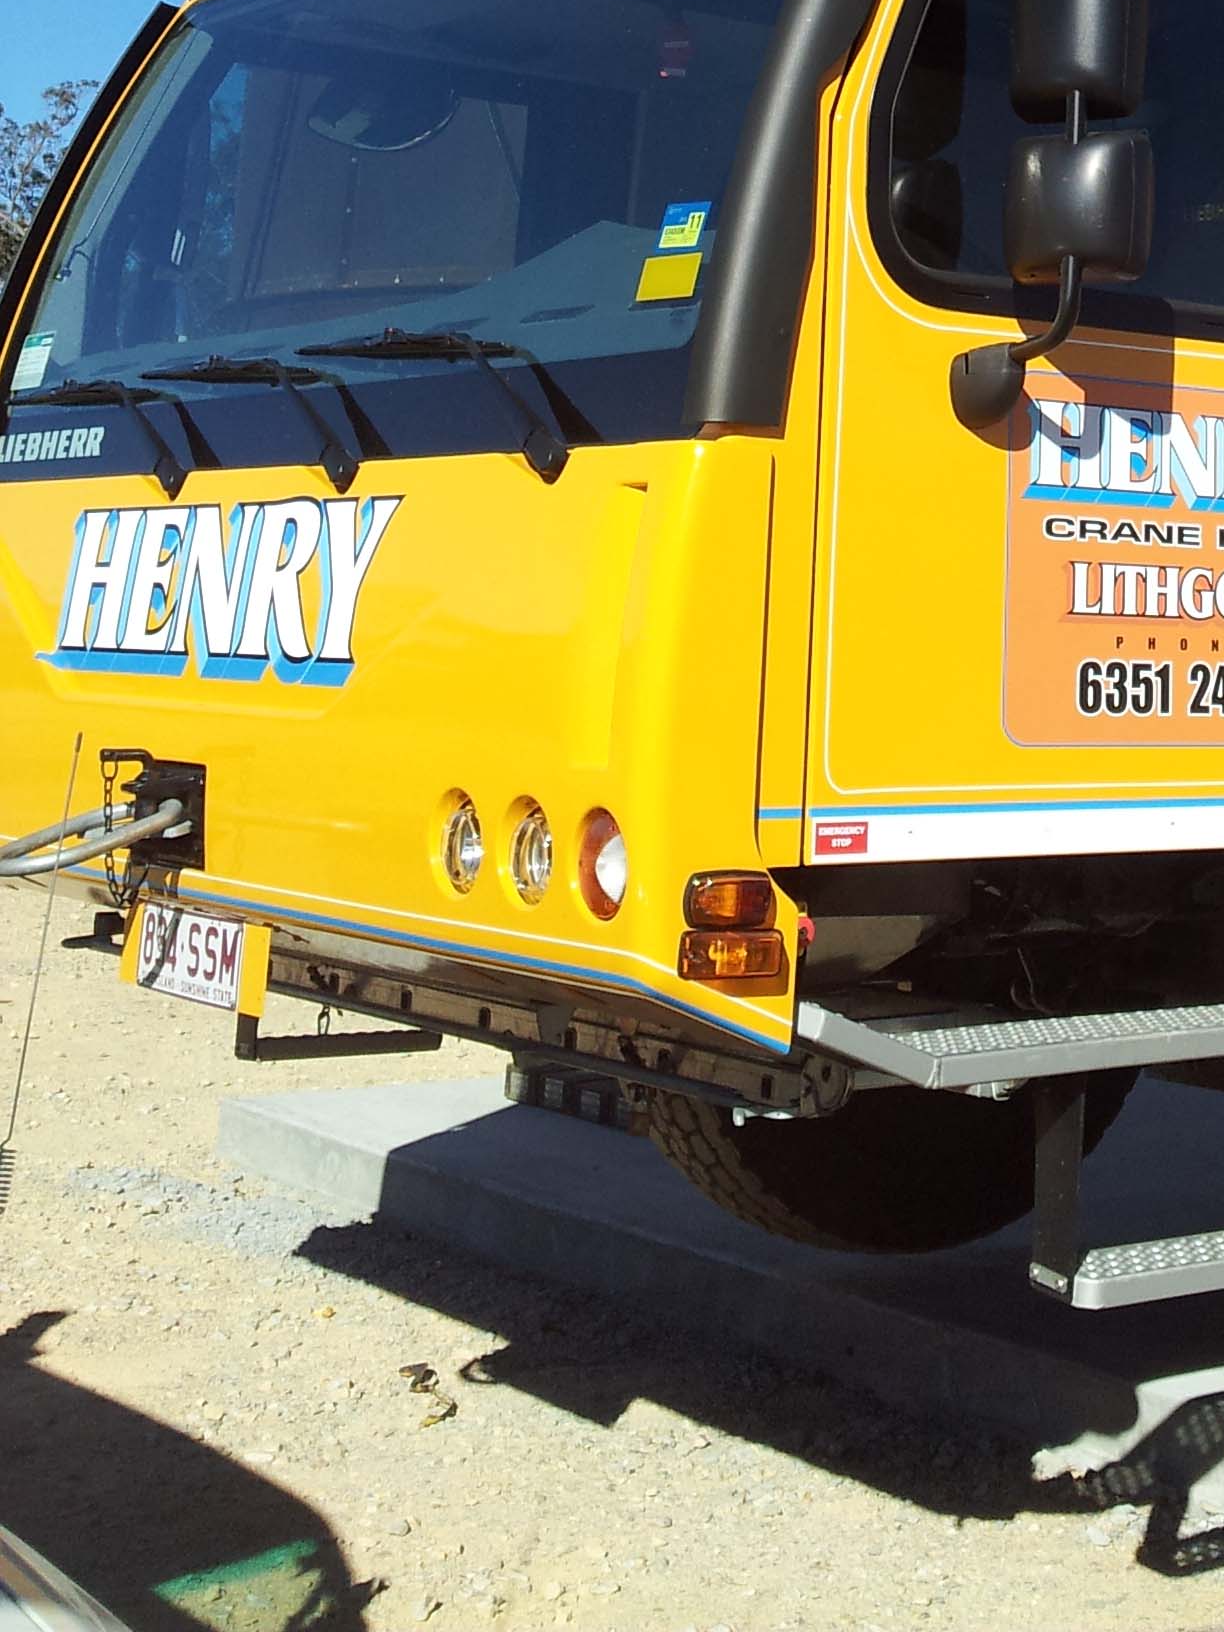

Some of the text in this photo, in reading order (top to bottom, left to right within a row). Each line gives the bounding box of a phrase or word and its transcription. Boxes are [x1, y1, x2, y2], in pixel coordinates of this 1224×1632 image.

[0, 426, 105, 464] LIEBHERR
[1043, 516, 1203, 548] CRANE
[35, 494, 406, 688] HENRY
[1076, 658, 1173, 718] 6351
[187, 922, 240, 987] SSM
